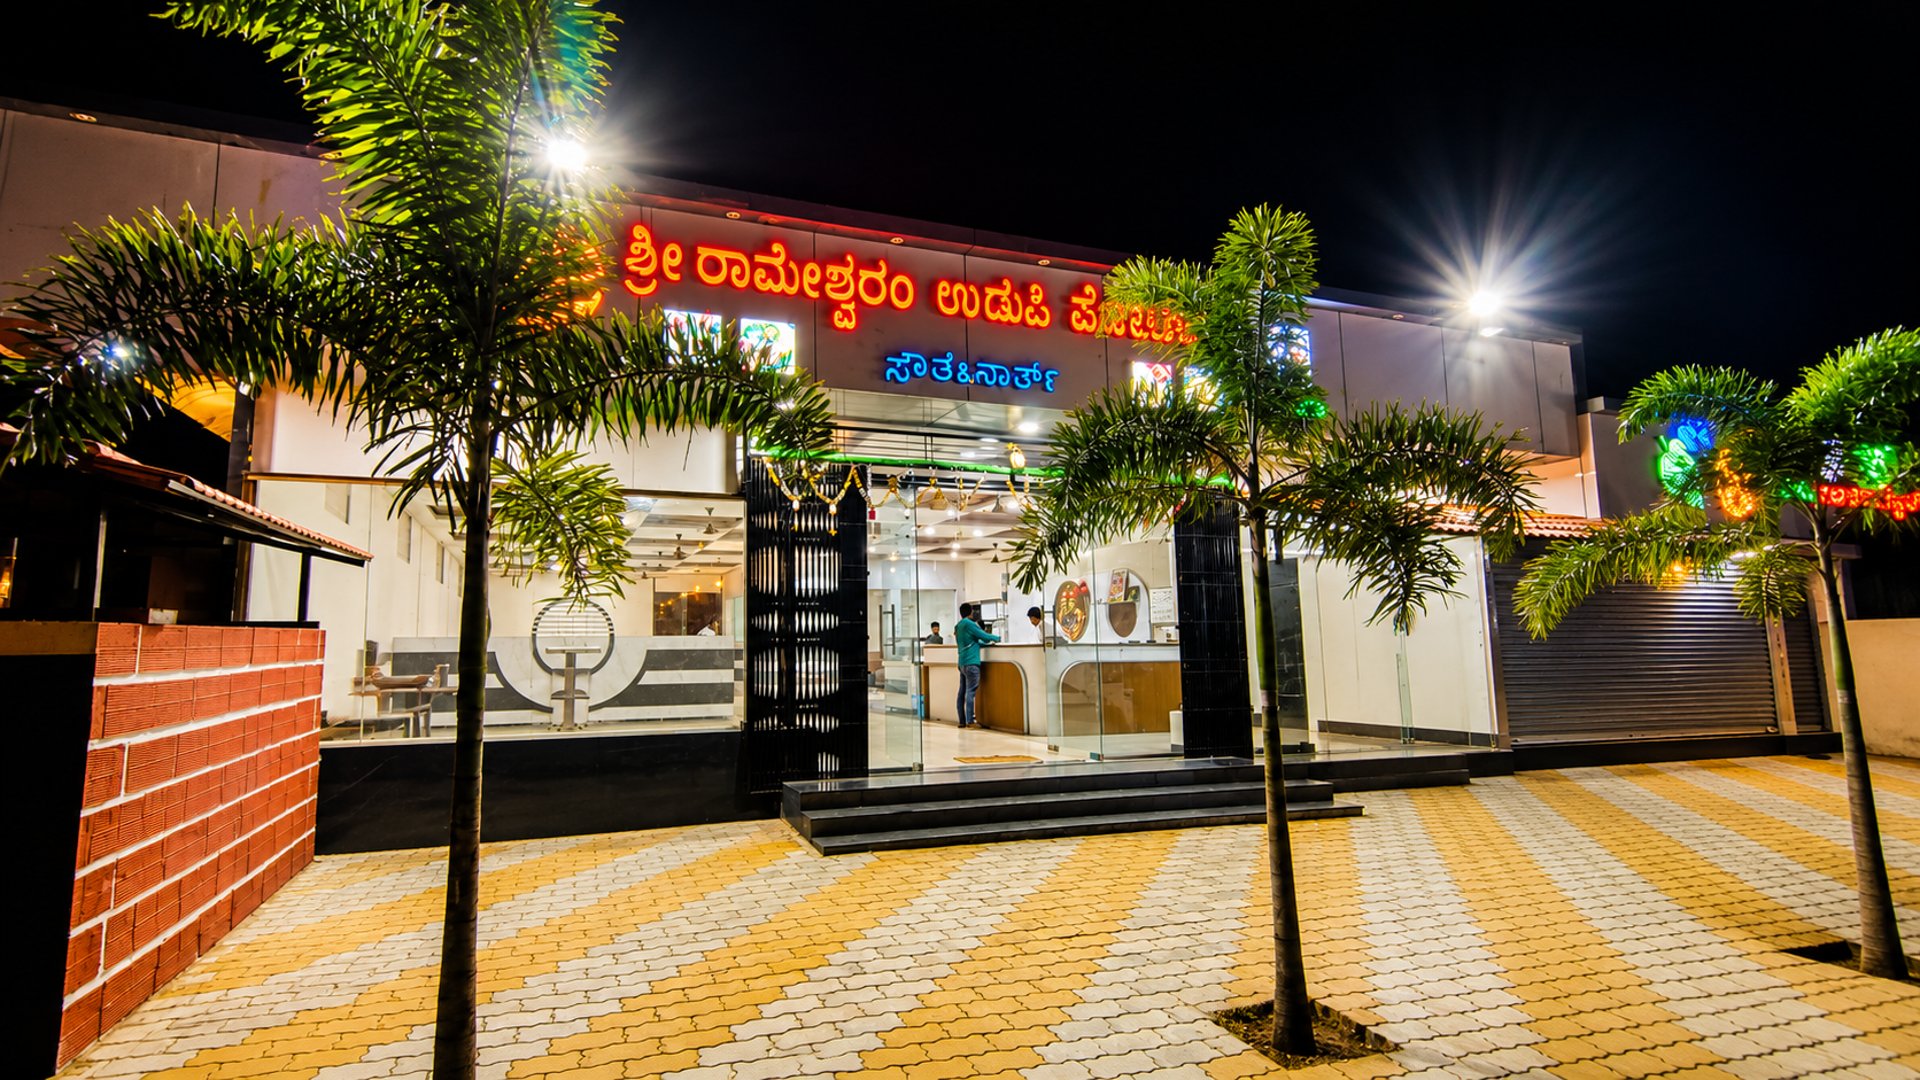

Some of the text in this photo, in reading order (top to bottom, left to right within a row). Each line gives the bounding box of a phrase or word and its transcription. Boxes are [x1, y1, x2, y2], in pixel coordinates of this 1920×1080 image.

[624, 223, 683, 296] ಶ್ರೀ
[696, 242, 914, 330] ರಾಮೇಶ್ವರಂ
[937, 279, 1052, 329] ಉಡುಪಿ
